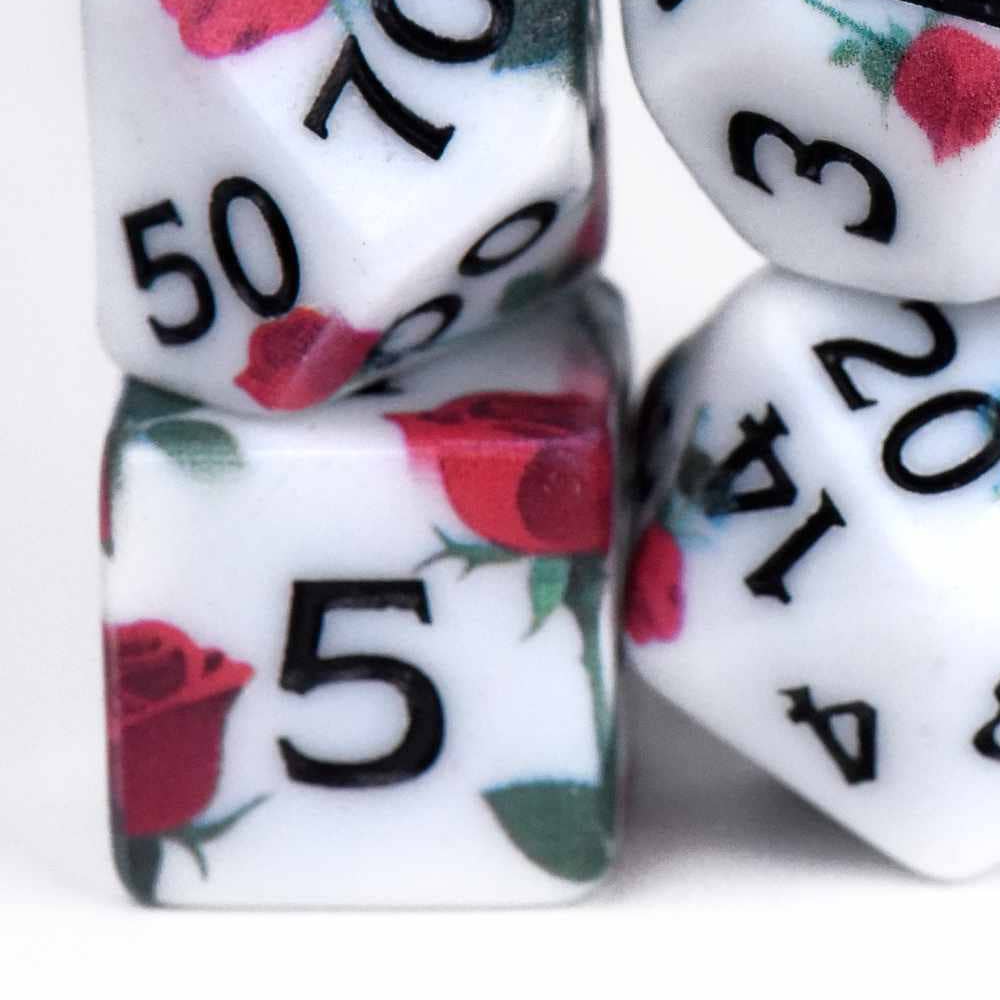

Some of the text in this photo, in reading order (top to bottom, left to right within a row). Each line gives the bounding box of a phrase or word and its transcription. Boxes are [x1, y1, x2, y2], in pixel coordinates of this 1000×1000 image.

[120, 176, 301, 346] 50
[727, 110, 897, 244] 3
[703, 402, 847, 604] 14
[279, 579, 444, 788] 5
[780, 686, 876, 784] 4
